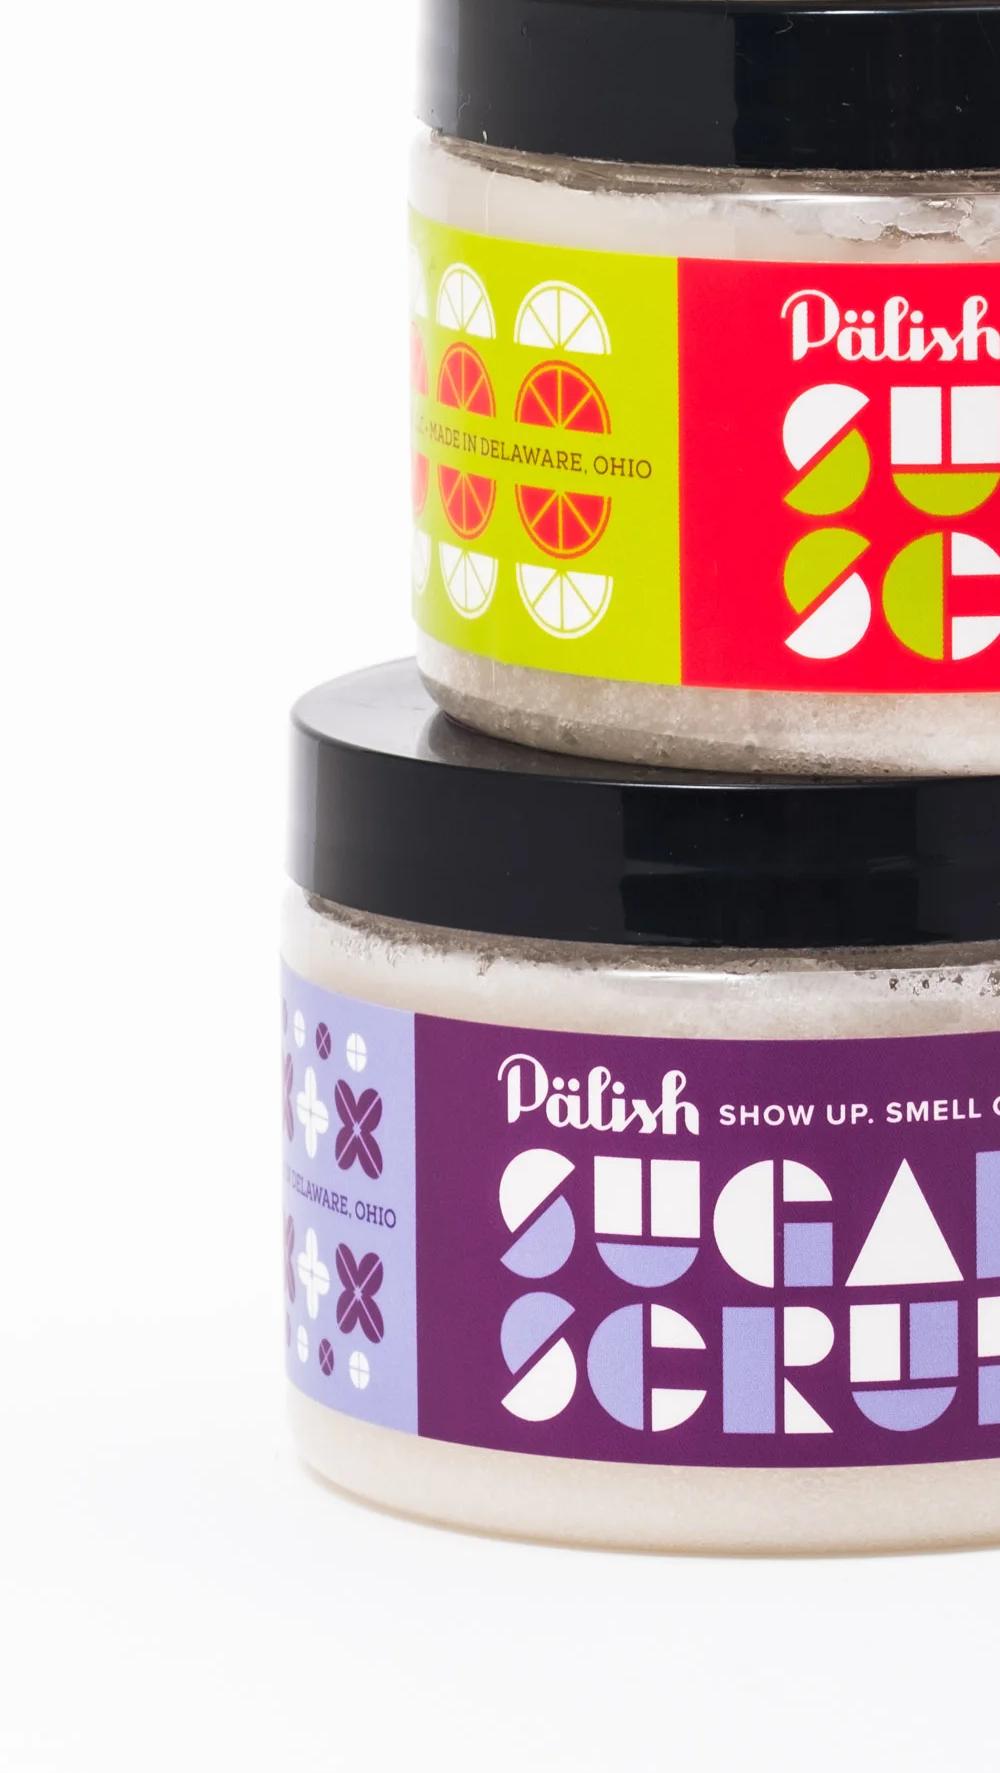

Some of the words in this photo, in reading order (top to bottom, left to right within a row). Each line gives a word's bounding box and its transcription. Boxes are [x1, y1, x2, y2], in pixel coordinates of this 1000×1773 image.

[780, 289, 1000, 362] Pälish
[430, 421, 460, 452] MADE
[462, 432, 477, 453] IN
[481, 436, 588, 475] DELAWARE,
[593, 455, 652, 480] OHIO
[498, 1054, 699, 1135] Pälish
[720, 1104, 814, 1126] SHOW
[827, 1104, 873, 1125] UP.
[887, 1098, 981, 1123] SMELL
[292, 1169, 351, 1219] DELAWARE,
[354, 1200, 396, 1229] OHIO
